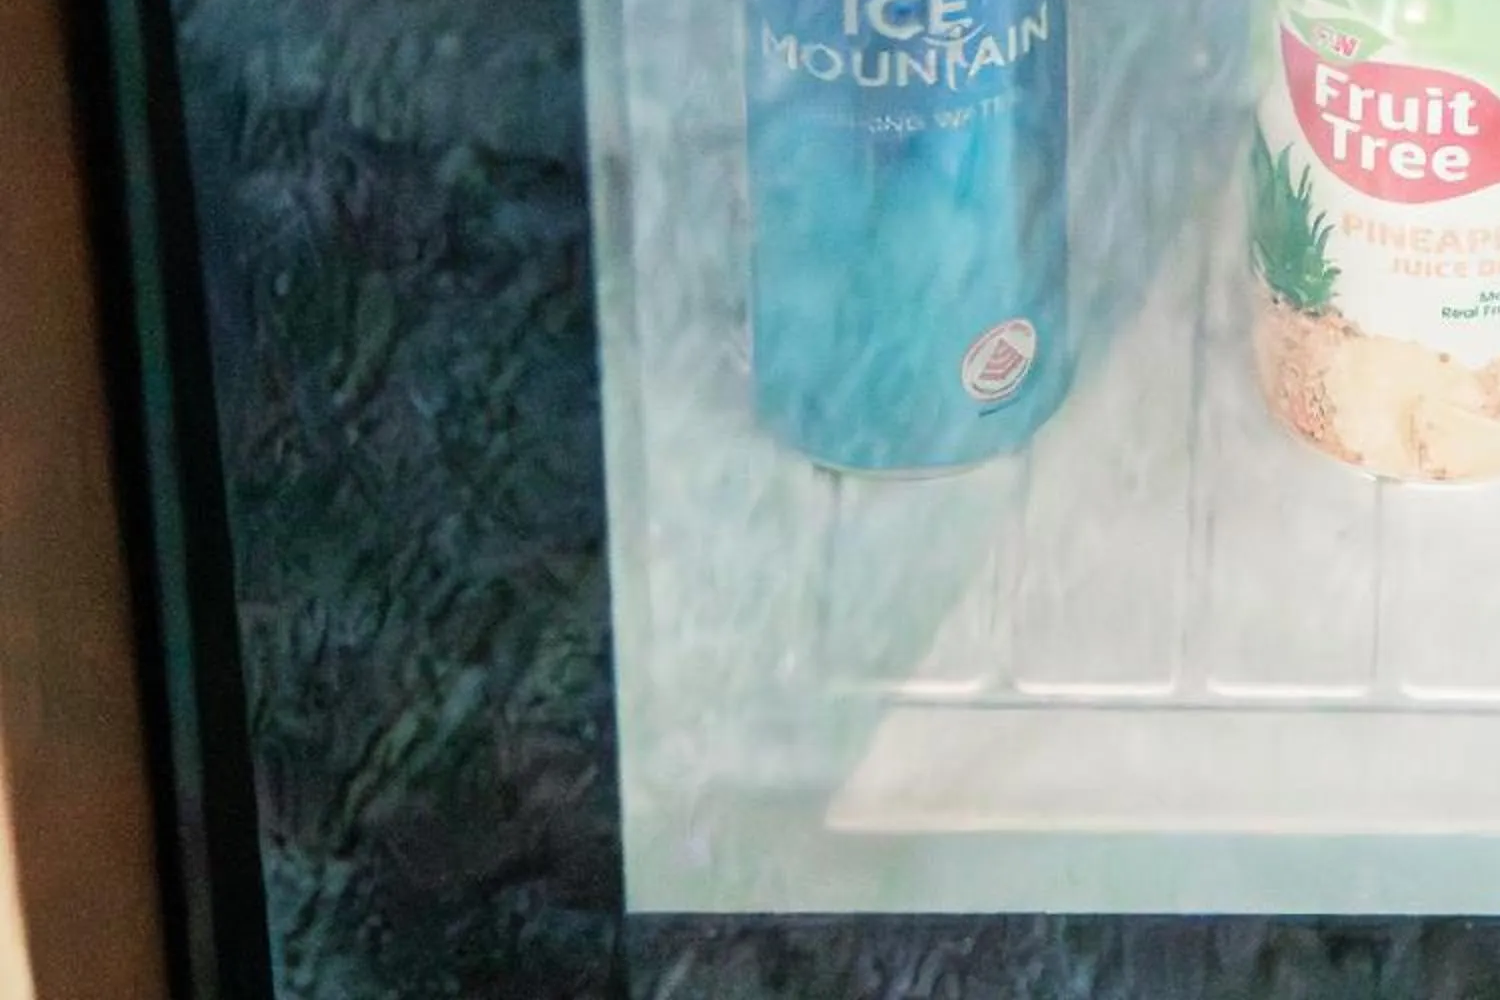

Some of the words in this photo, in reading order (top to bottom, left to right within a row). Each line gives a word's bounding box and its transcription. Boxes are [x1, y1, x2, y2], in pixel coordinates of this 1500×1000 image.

[762, 0, 1049, 91] MOUNTAIN
[1315, 63, 1479, 137] Fruit
[1321, 113, 1471, 183] Tree
[1392, 257, 1468, 278] JUICE
[1441, 305, 1480, 319] Real
